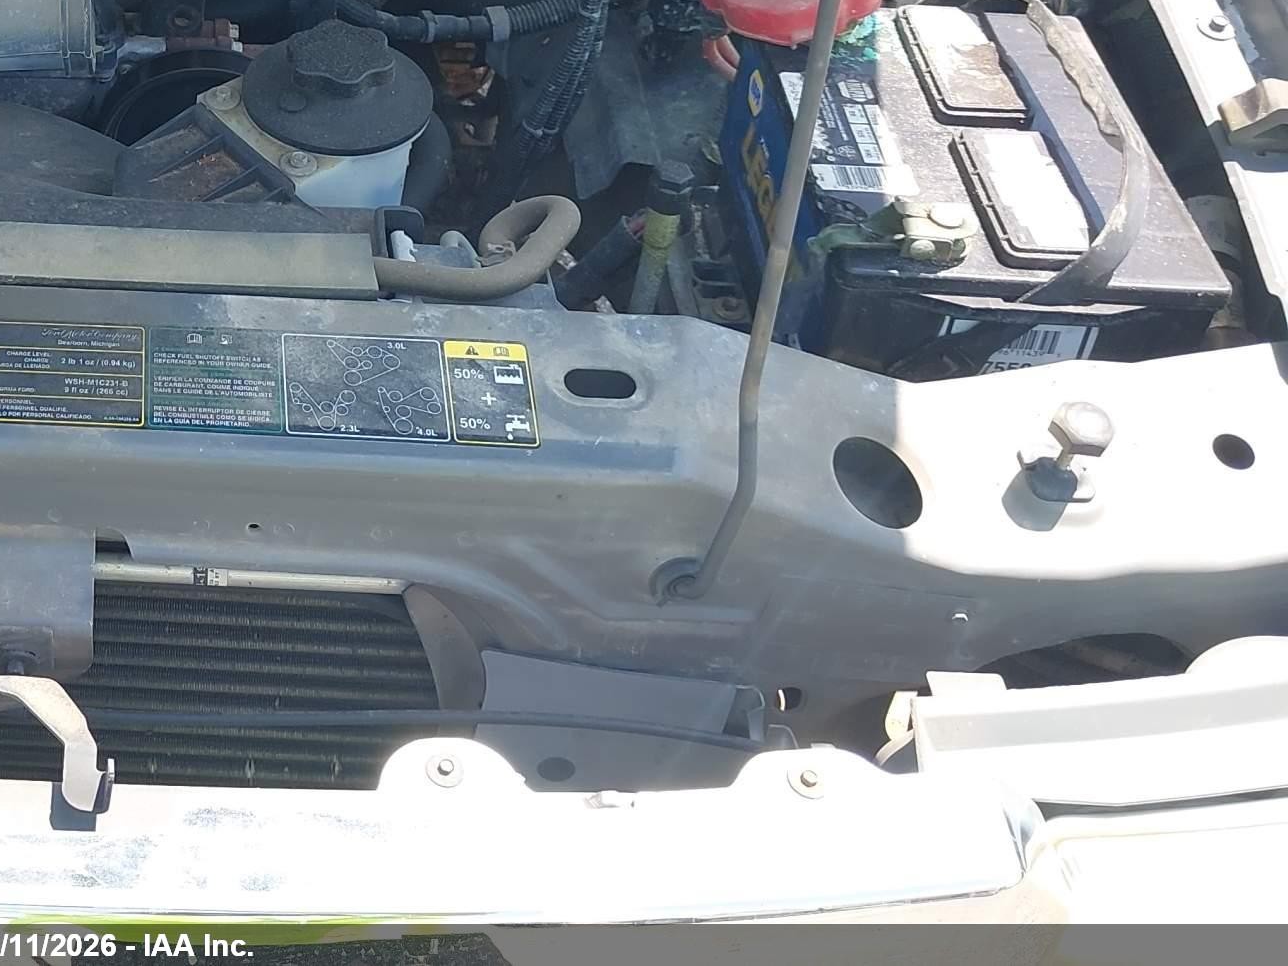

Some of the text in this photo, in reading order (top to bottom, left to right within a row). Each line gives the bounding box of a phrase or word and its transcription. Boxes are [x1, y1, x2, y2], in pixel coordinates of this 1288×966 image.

[386, 342, 407, 351] 3.0L
[122, 360, 136, 368] kg)
[453, 368, 485, 380] 50%
[459, 417, 491, 430] 50%
[340, 424, 361, 433] 2.3L
[418, 427, 438, 437] 4.0L
